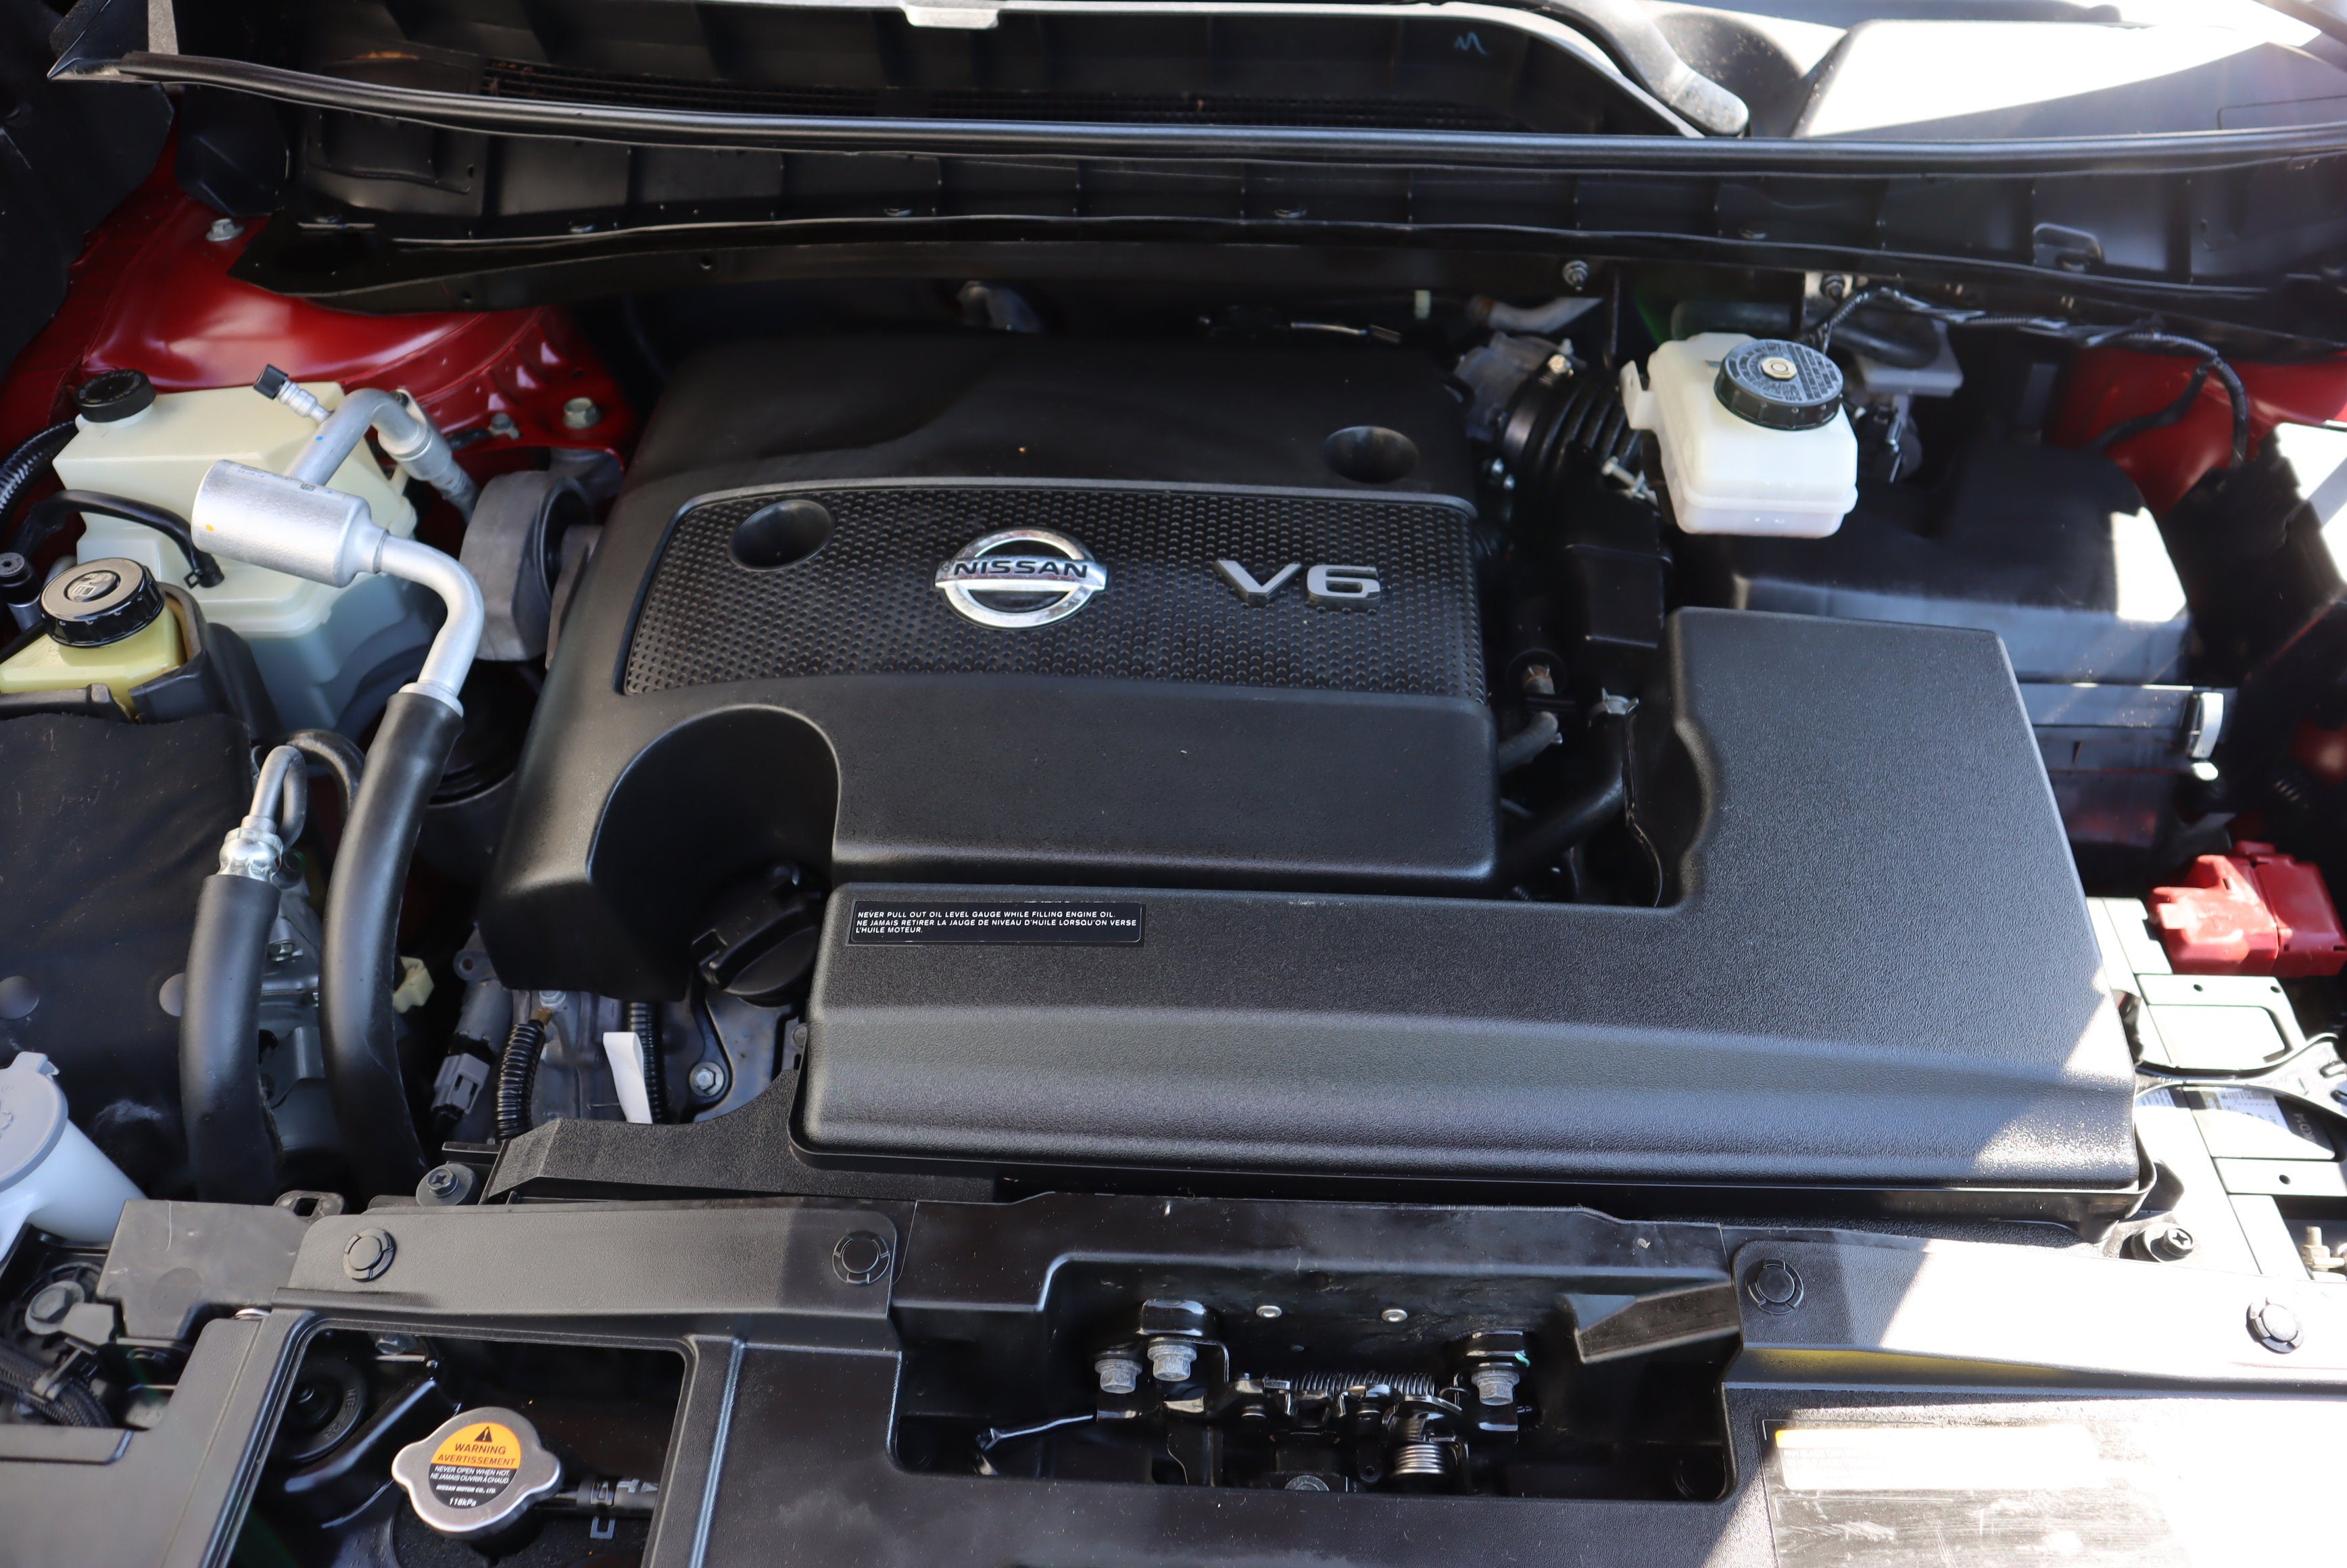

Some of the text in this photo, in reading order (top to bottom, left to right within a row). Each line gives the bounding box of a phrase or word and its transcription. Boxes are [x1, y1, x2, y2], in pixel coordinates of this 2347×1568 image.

[954, 560, 1088, 579] NISSAN
[1215, 558, 1381, 604] V6
[455, 1443, 506, 1455] WARNING
[437, 1454, 516, 1466] AVERTISSEMENT
[435, 1465, 456, 1473] NEVER
[456, 1467, 475, 1475] OPEN
[476, 1468, 495, 1476] WHEN
[460, 1475, 483, 1483] OUVRIR
[450, 1497, 477, 1507] 118kPa
